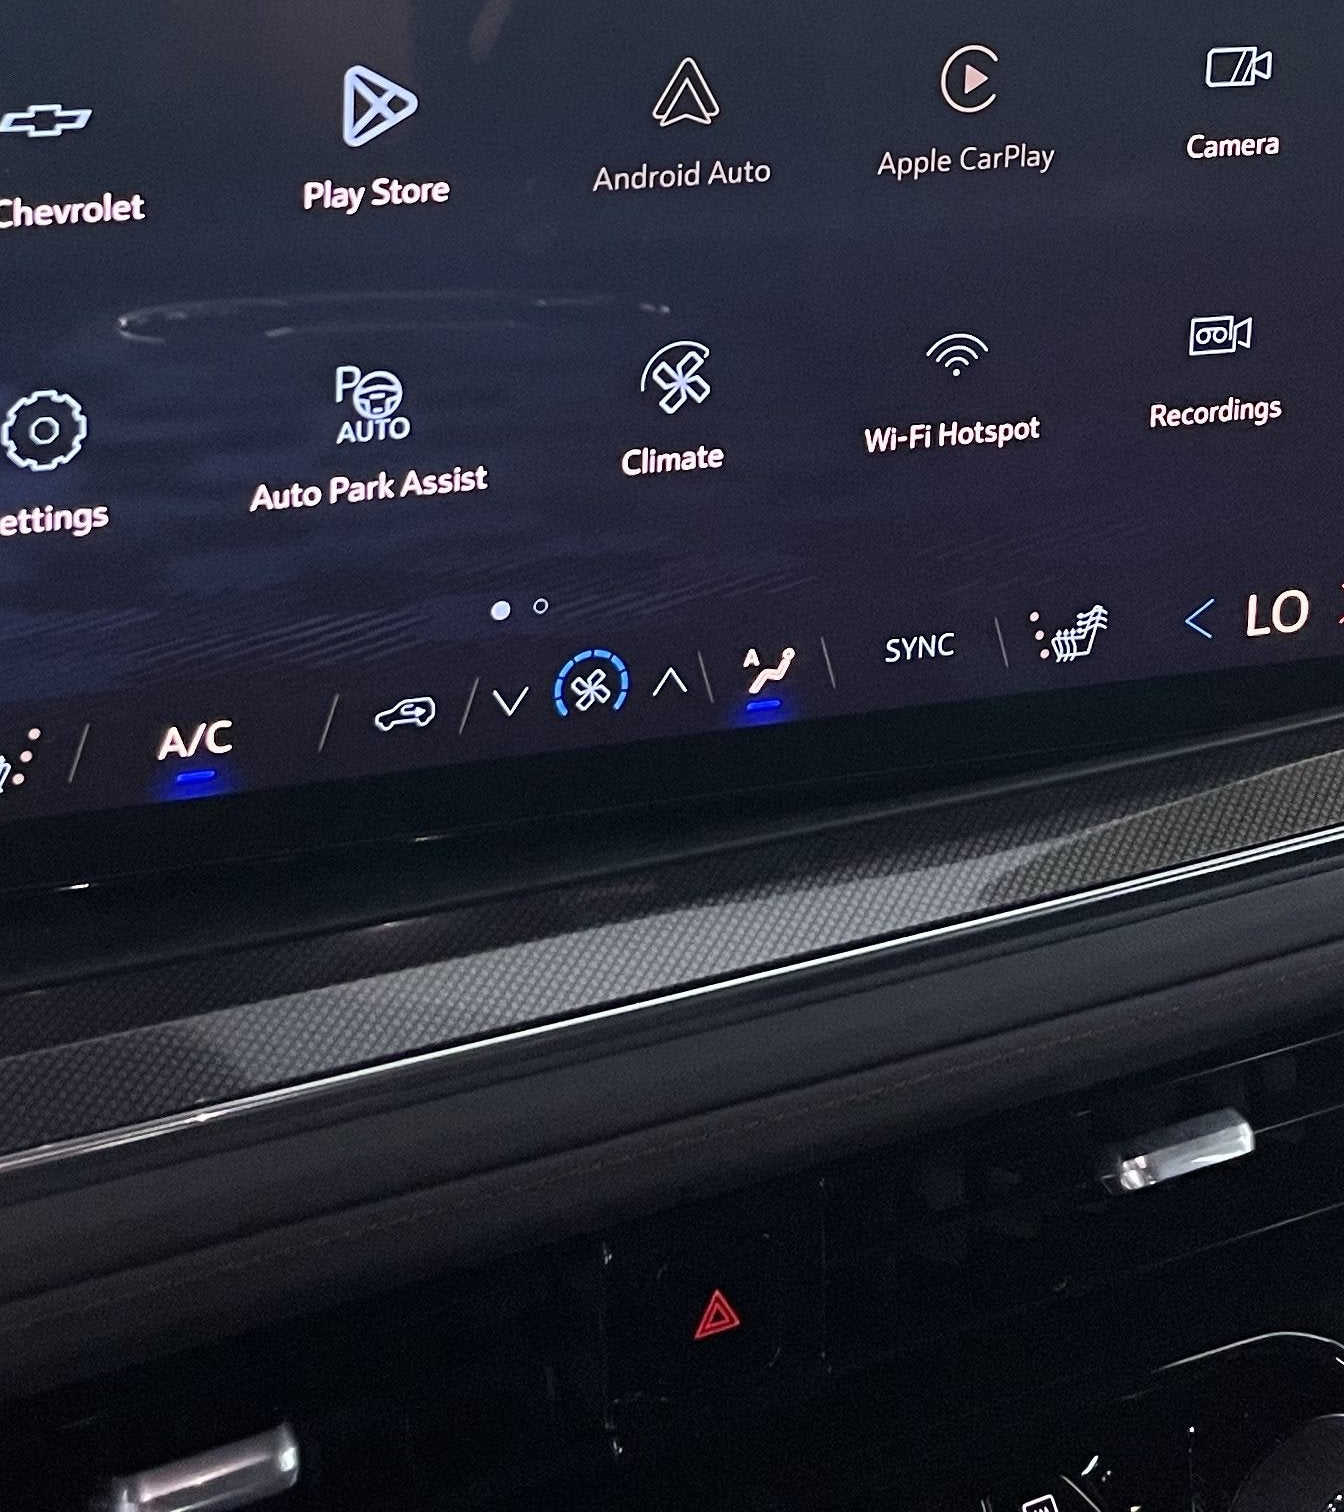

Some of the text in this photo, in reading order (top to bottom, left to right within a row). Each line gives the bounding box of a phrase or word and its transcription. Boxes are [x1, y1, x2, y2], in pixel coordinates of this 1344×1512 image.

[877, 142, 1055, 181] Apple CarPlay
[1186, 133, 1280, 159] Camera
[592, 160, 771, 192] Android Auto
[303, 177, 451, 215] Play Store
[335, 365, 362, 403] P
[1150, 396, 1283, 428] Recordings
[336, 416, 411, 445] AUTO
[864, 416, 1041, 453] Wi-Fi Hotspot
[621, 445, 725, 476] Climate
[249, 465, 489, 513] Auto Park Assist
[1246, 589, 1309, 637] LO
[742, 648, 761, 668] A
[885, 632, 955, 663] SYNC
[157, 719, 233, 761] A/C
